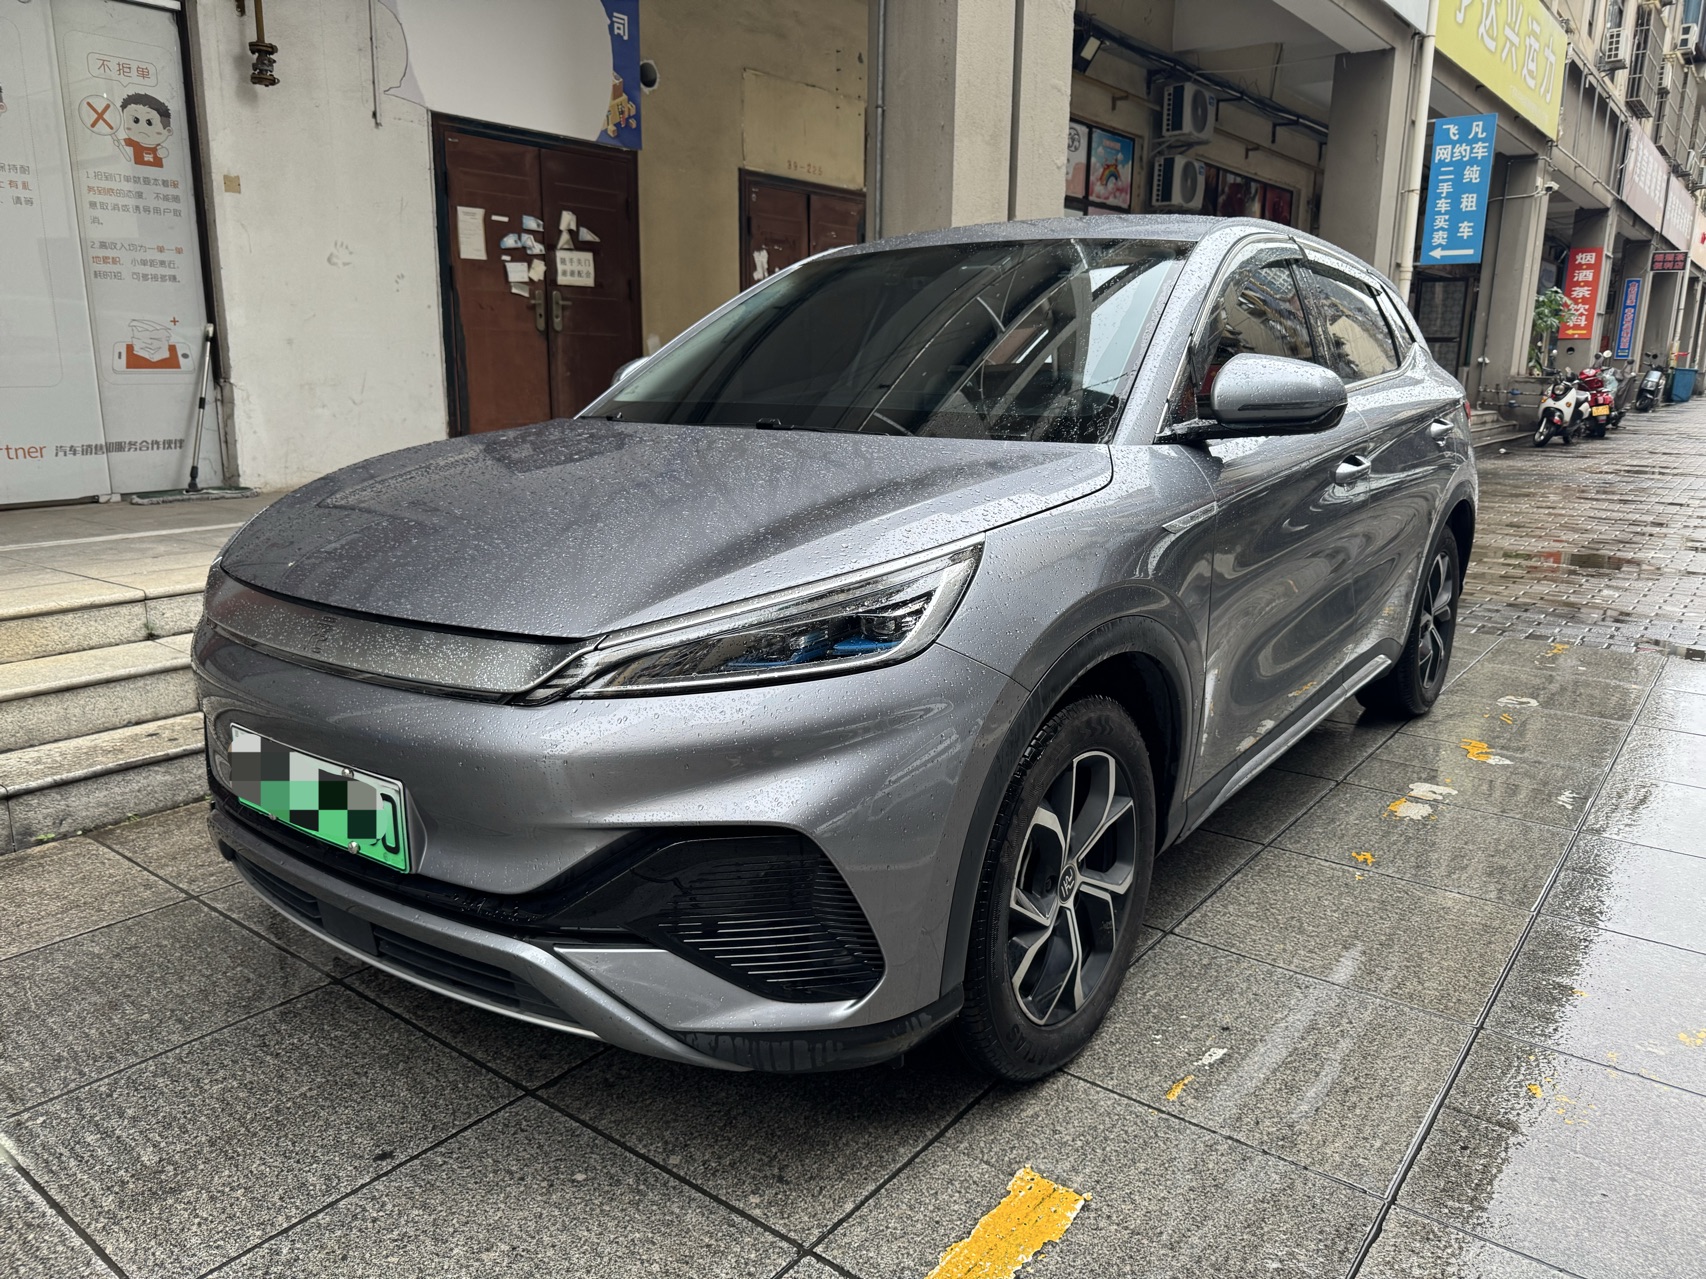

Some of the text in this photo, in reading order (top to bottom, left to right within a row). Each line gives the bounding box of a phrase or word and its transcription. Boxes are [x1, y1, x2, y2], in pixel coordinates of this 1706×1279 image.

[612, 12, 629, 41] 司
[1455, 0, 1556, 104] 达兴运力
[96, 57, 151, 80] 不拒单
[1442, 121, 1487, 141] 飞凡
[1434, 142, 1489, 163] 网约车
[1431, 166, 1455, 247] 二手车买卖
[1457, 165, 1480, 241] 纯租车
[54, 438, 185, 458] 汽车销售和服务合作伙伴
